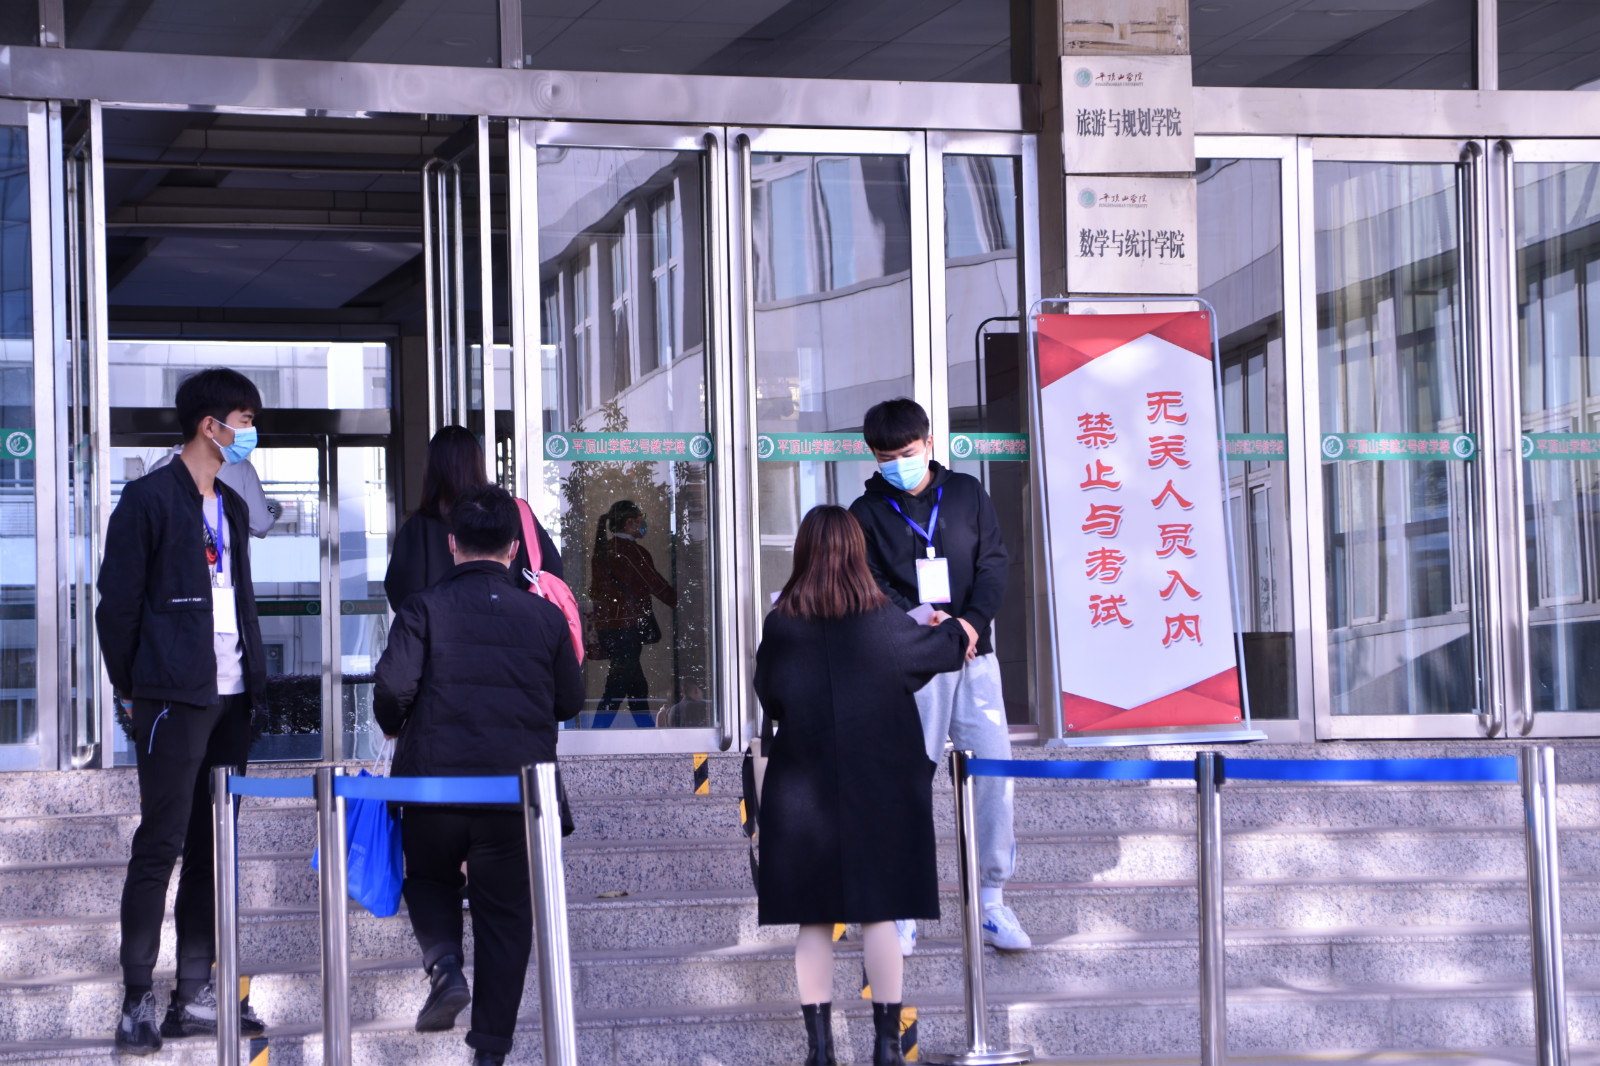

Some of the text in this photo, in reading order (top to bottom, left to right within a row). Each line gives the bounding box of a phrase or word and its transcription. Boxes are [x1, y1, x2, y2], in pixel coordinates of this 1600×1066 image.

[1076, 107, 1182, 137] 旅游与规划学院
[1079, 228, 1185, 258] 数学与统计学院
[572, 438, 686, 454] 平顶山学院2号教学楼
[1346, 439, 1450, 454] 平顶山学院2号教学楼
[1536, 439, 1600, 454] 平顶山学院2
[1076, 411, 1133, 627] 禁止与考试
[1146, 390, 1202, 647] 无关人员入内
